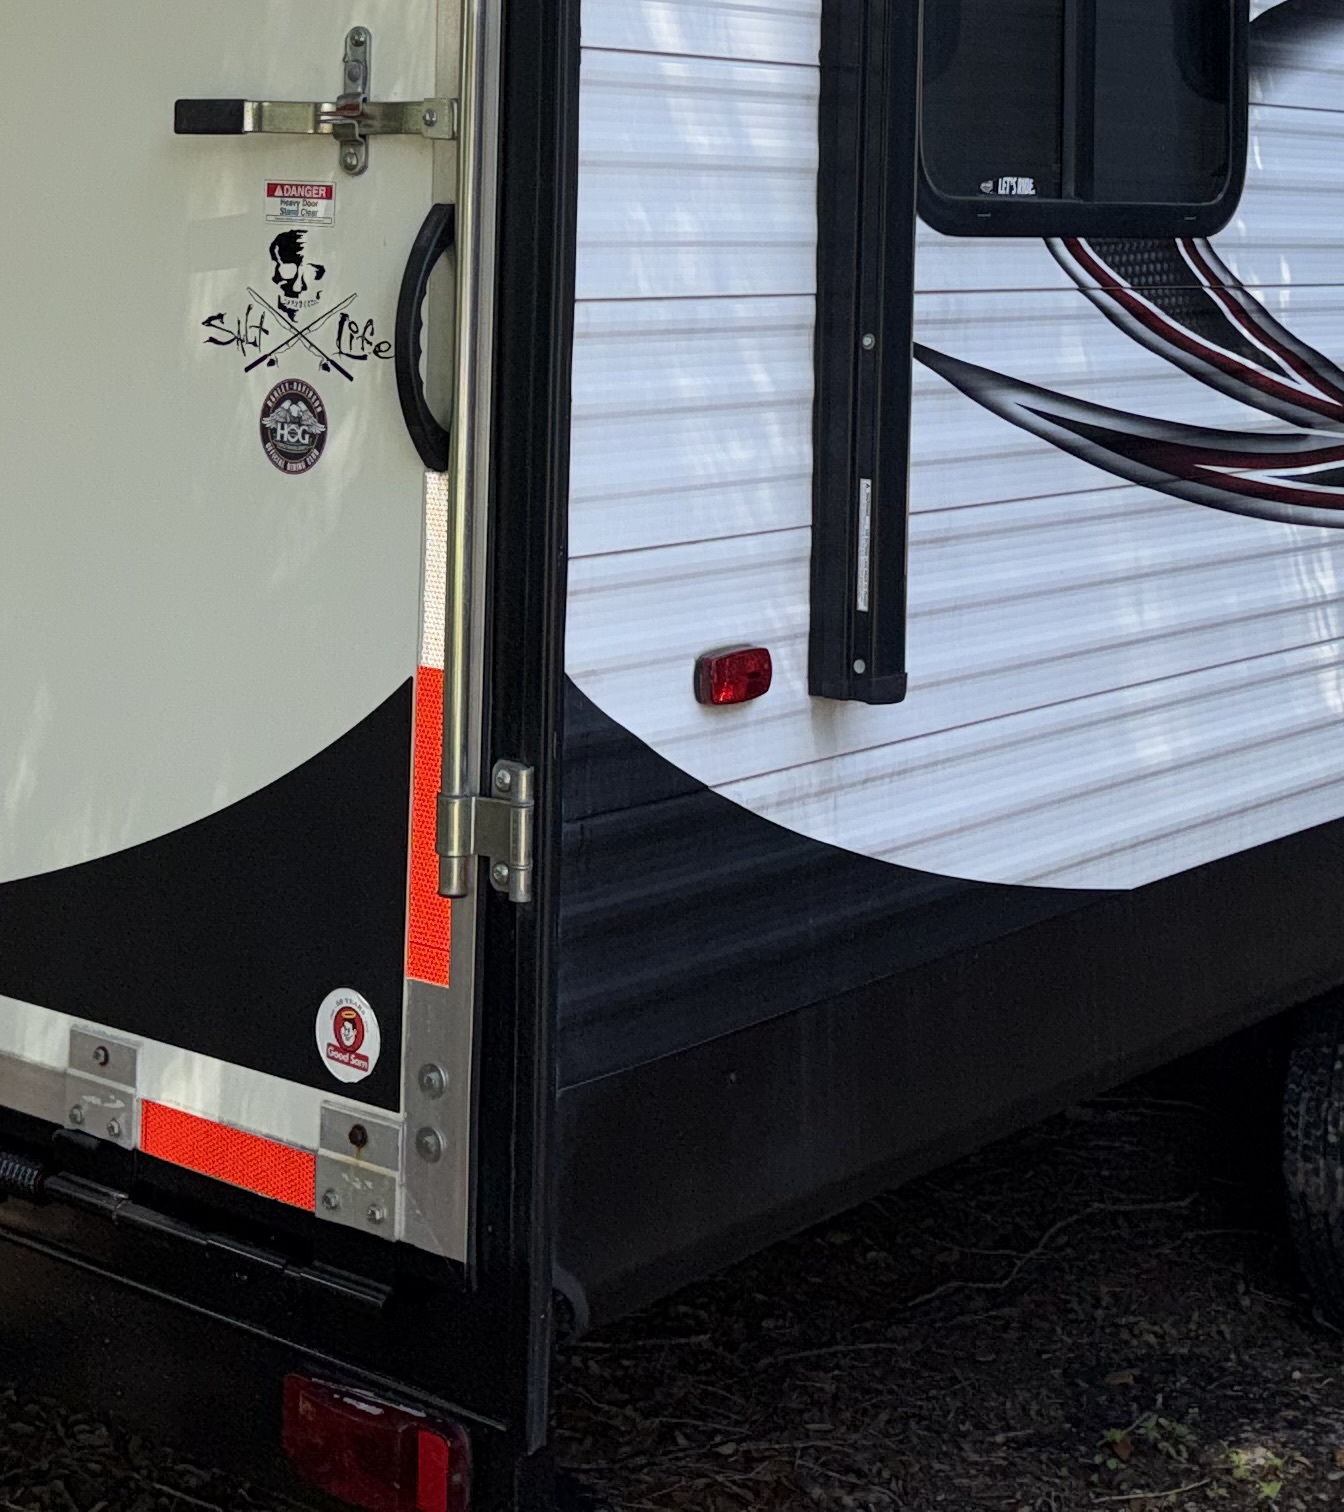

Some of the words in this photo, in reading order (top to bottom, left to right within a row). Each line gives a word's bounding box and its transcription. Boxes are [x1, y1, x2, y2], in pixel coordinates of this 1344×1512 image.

[283, 184, 327, 198] DANGER
[302, 198, 319, 207] Door
[328, 1048, 349, 1062] Good
[350, 1054, 368, 1068] Sam
